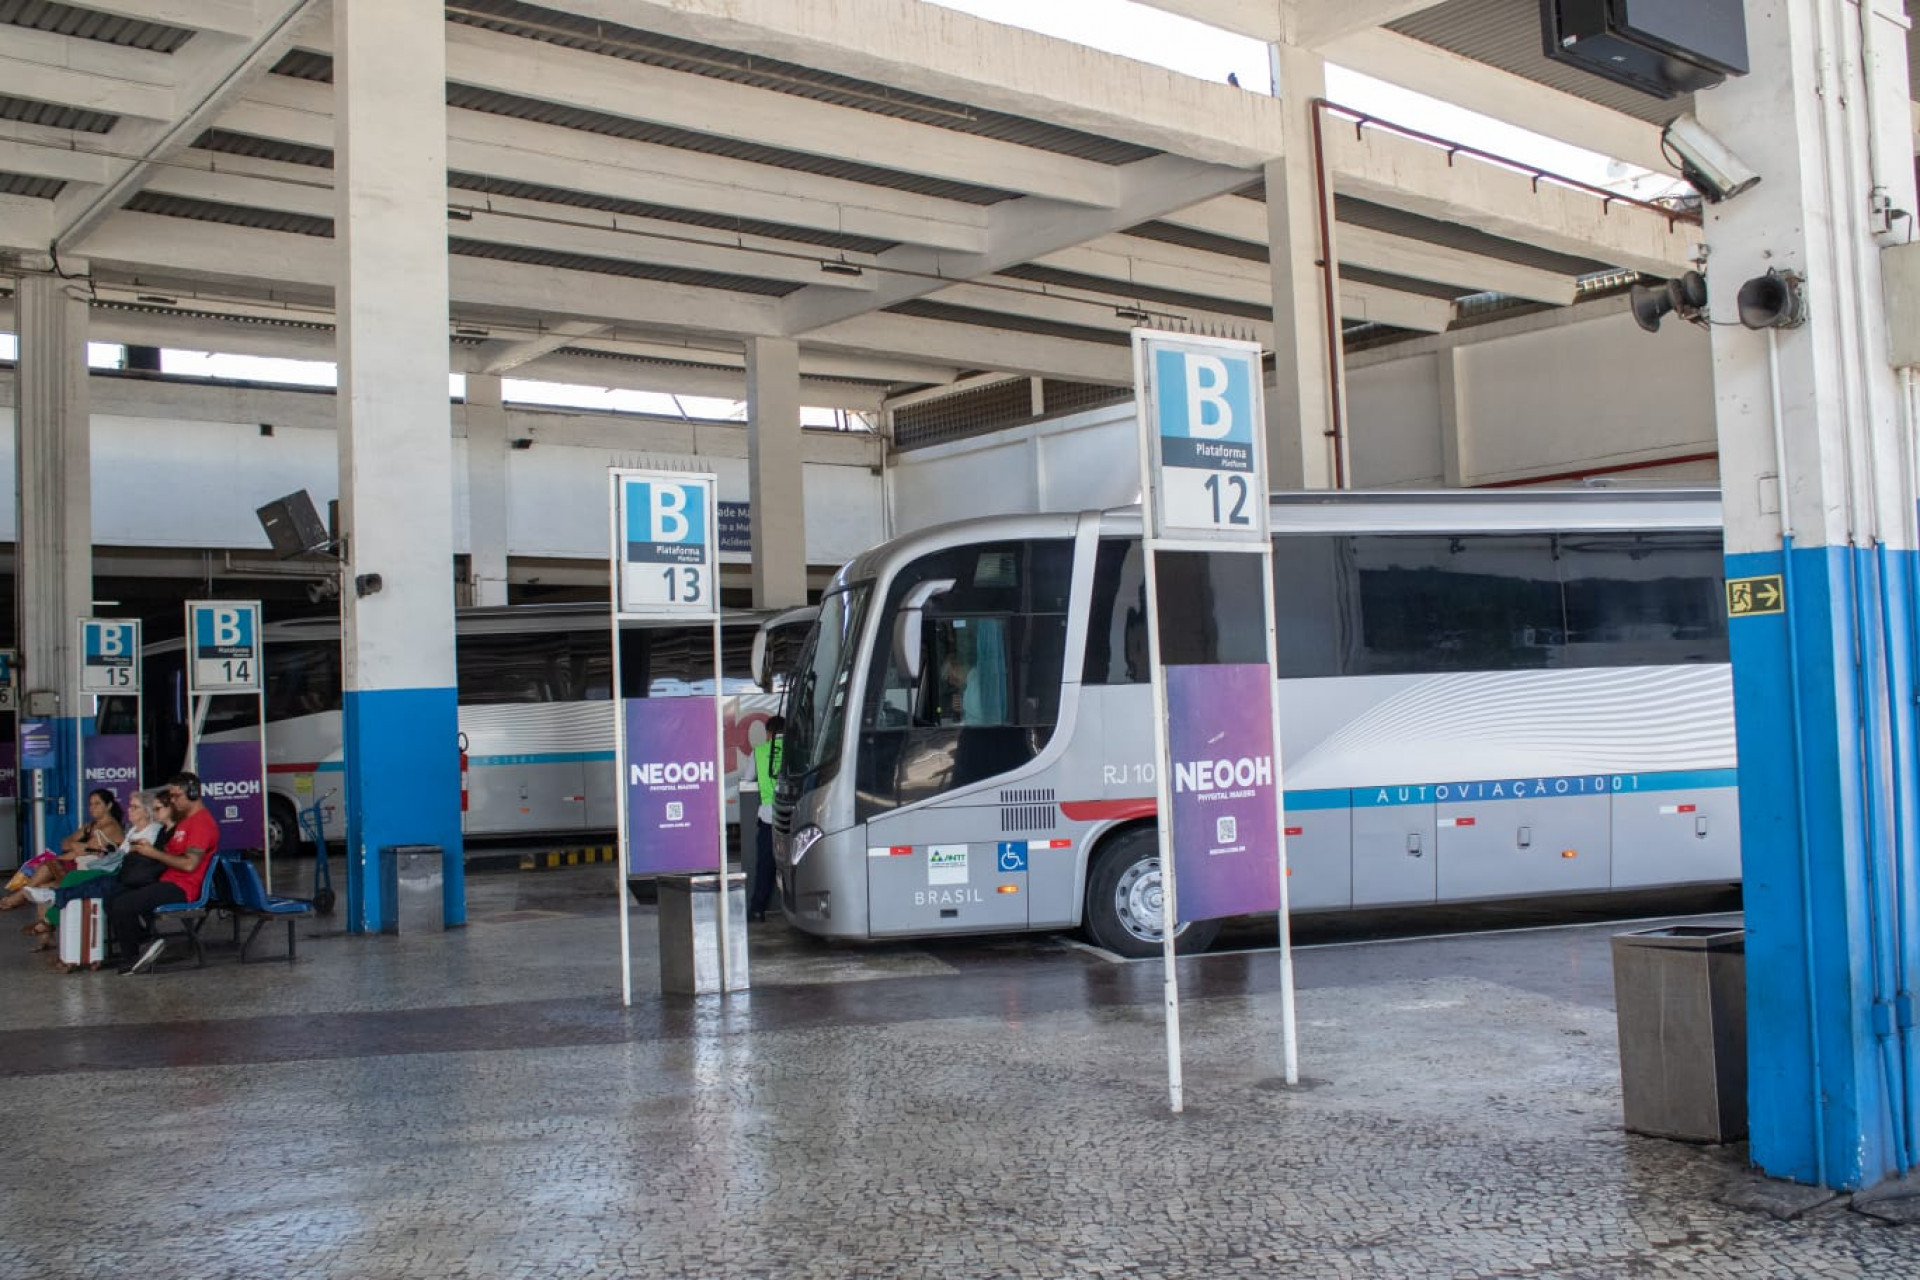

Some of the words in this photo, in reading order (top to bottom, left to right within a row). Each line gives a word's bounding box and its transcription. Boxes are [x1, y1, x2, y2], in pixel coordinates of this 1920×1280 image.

[1184, 353, 1232, 439] B
[1196, 442, 1246, 460] Plataforma
[1204, 473, 1250, 525] 12
[650, 483, 689, 542] B
[656, 545, 700, 556] Plataforma
[662, 566, 701, 603] 13
[213, 608, 242, 647] B
[100, 625, 123, 656] B
[106, 667, 130, 686] 15
[222, 660, 250, 682] 14
[86, 767, 137, 780] NEOOH
[630, 761, 714, 786] NEOOH
[1103, 764, 1128, 785] RJ
[1175, 755, 1273, 793] NEOOH
[200, 780, 261, 797] NEOOH
[914, 888, 984, 905] BRASIL
